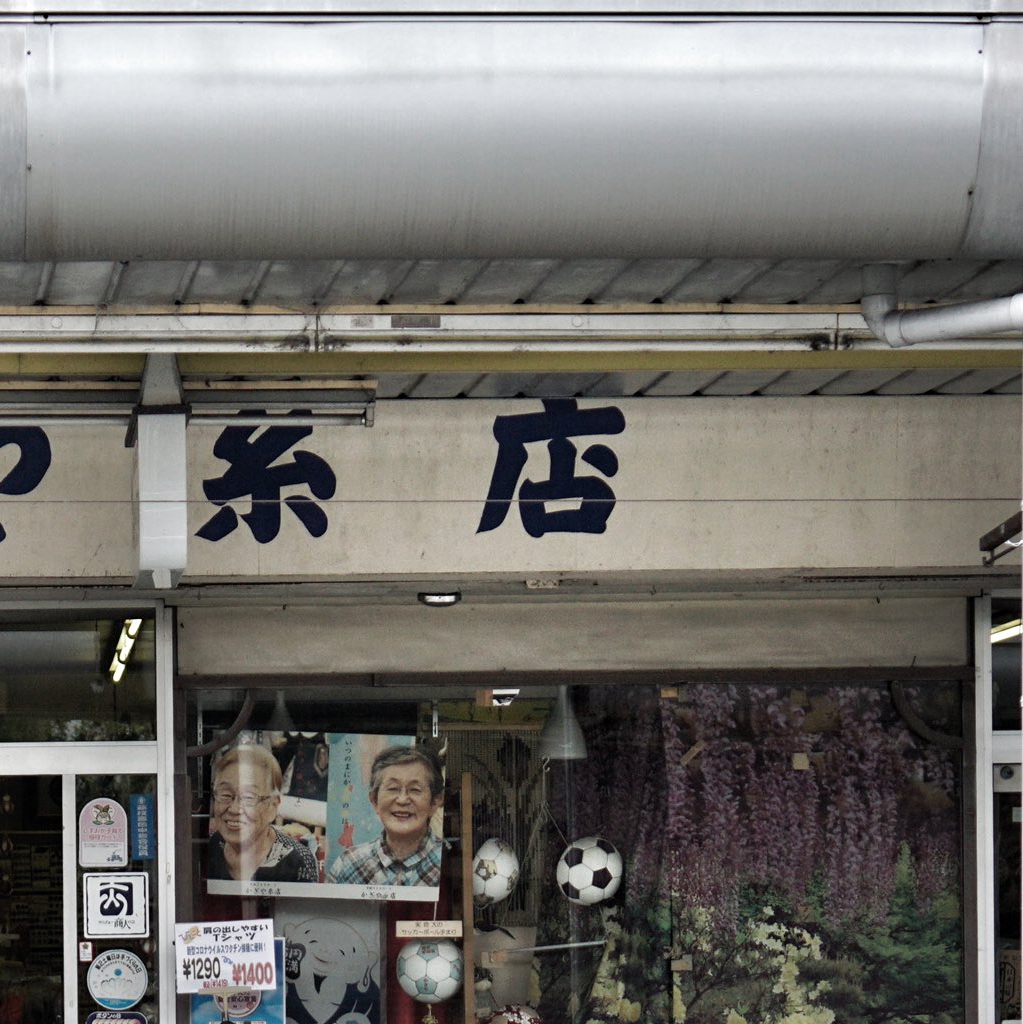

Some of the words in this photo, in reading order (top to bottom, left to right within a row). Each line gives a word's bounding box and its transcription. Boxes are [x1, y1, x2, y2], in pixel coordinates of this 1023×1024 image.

[203, 924, 268, 934] 肩の出しやすい
[213, 932, 256, 942] Tシャツ
[183, 957, 221, 980] ¥1290
[232, 962, 273, 985] ¥1400
